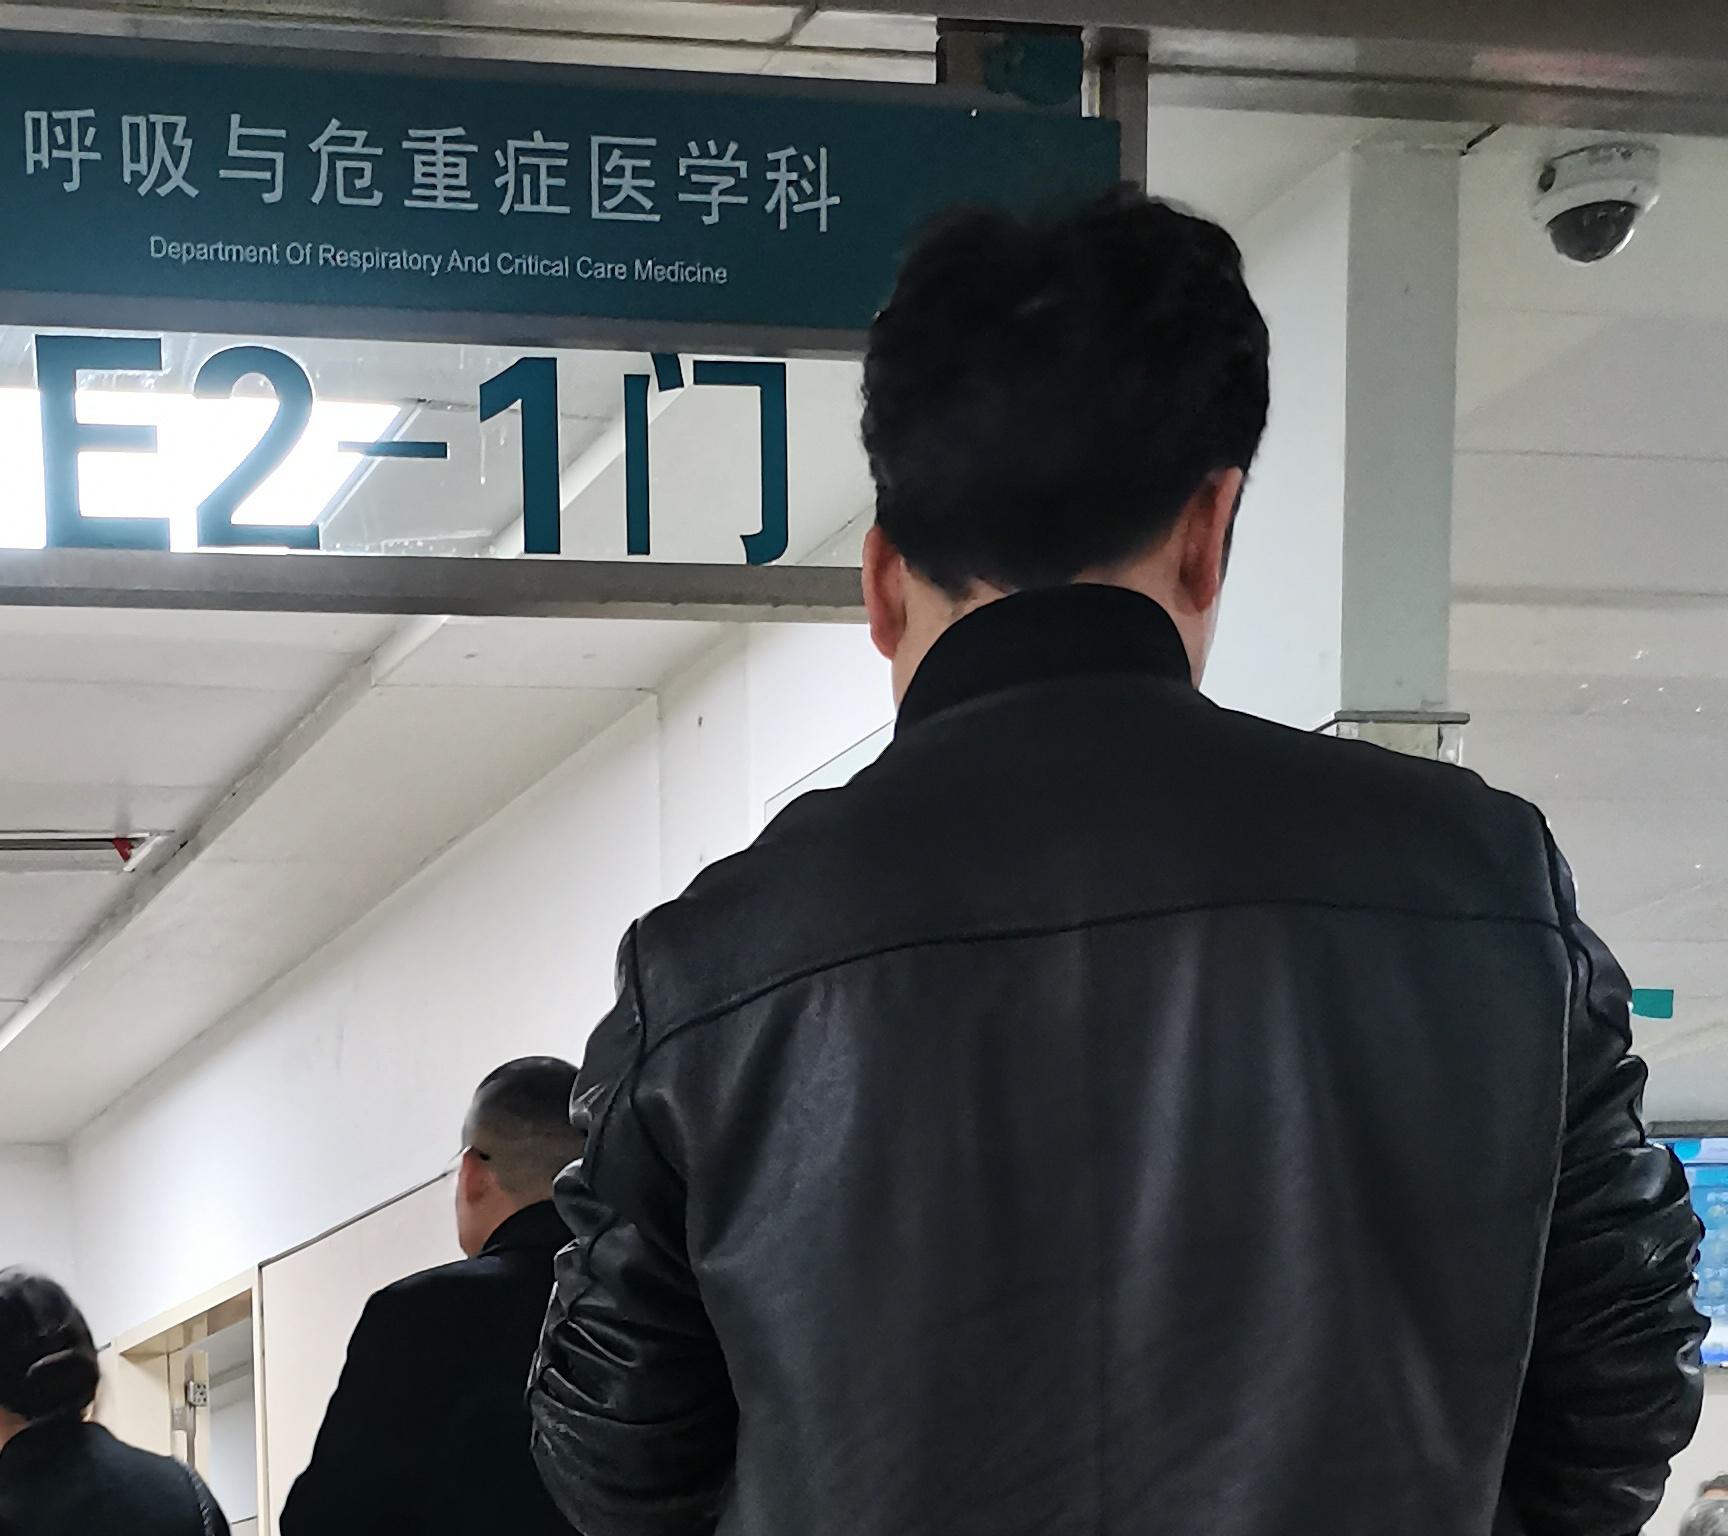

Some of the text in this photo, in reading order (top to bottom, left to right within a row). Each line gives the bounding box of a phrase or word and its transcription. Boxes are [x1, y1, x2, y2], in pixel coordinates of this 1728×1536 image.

[23, 108, 841, 232] 呼吸与危重症医学科
[148, 235, 728, 284] Department Of Respiratory And Critical Care Medicine
[34, 334, 790, 565] E2-1门
